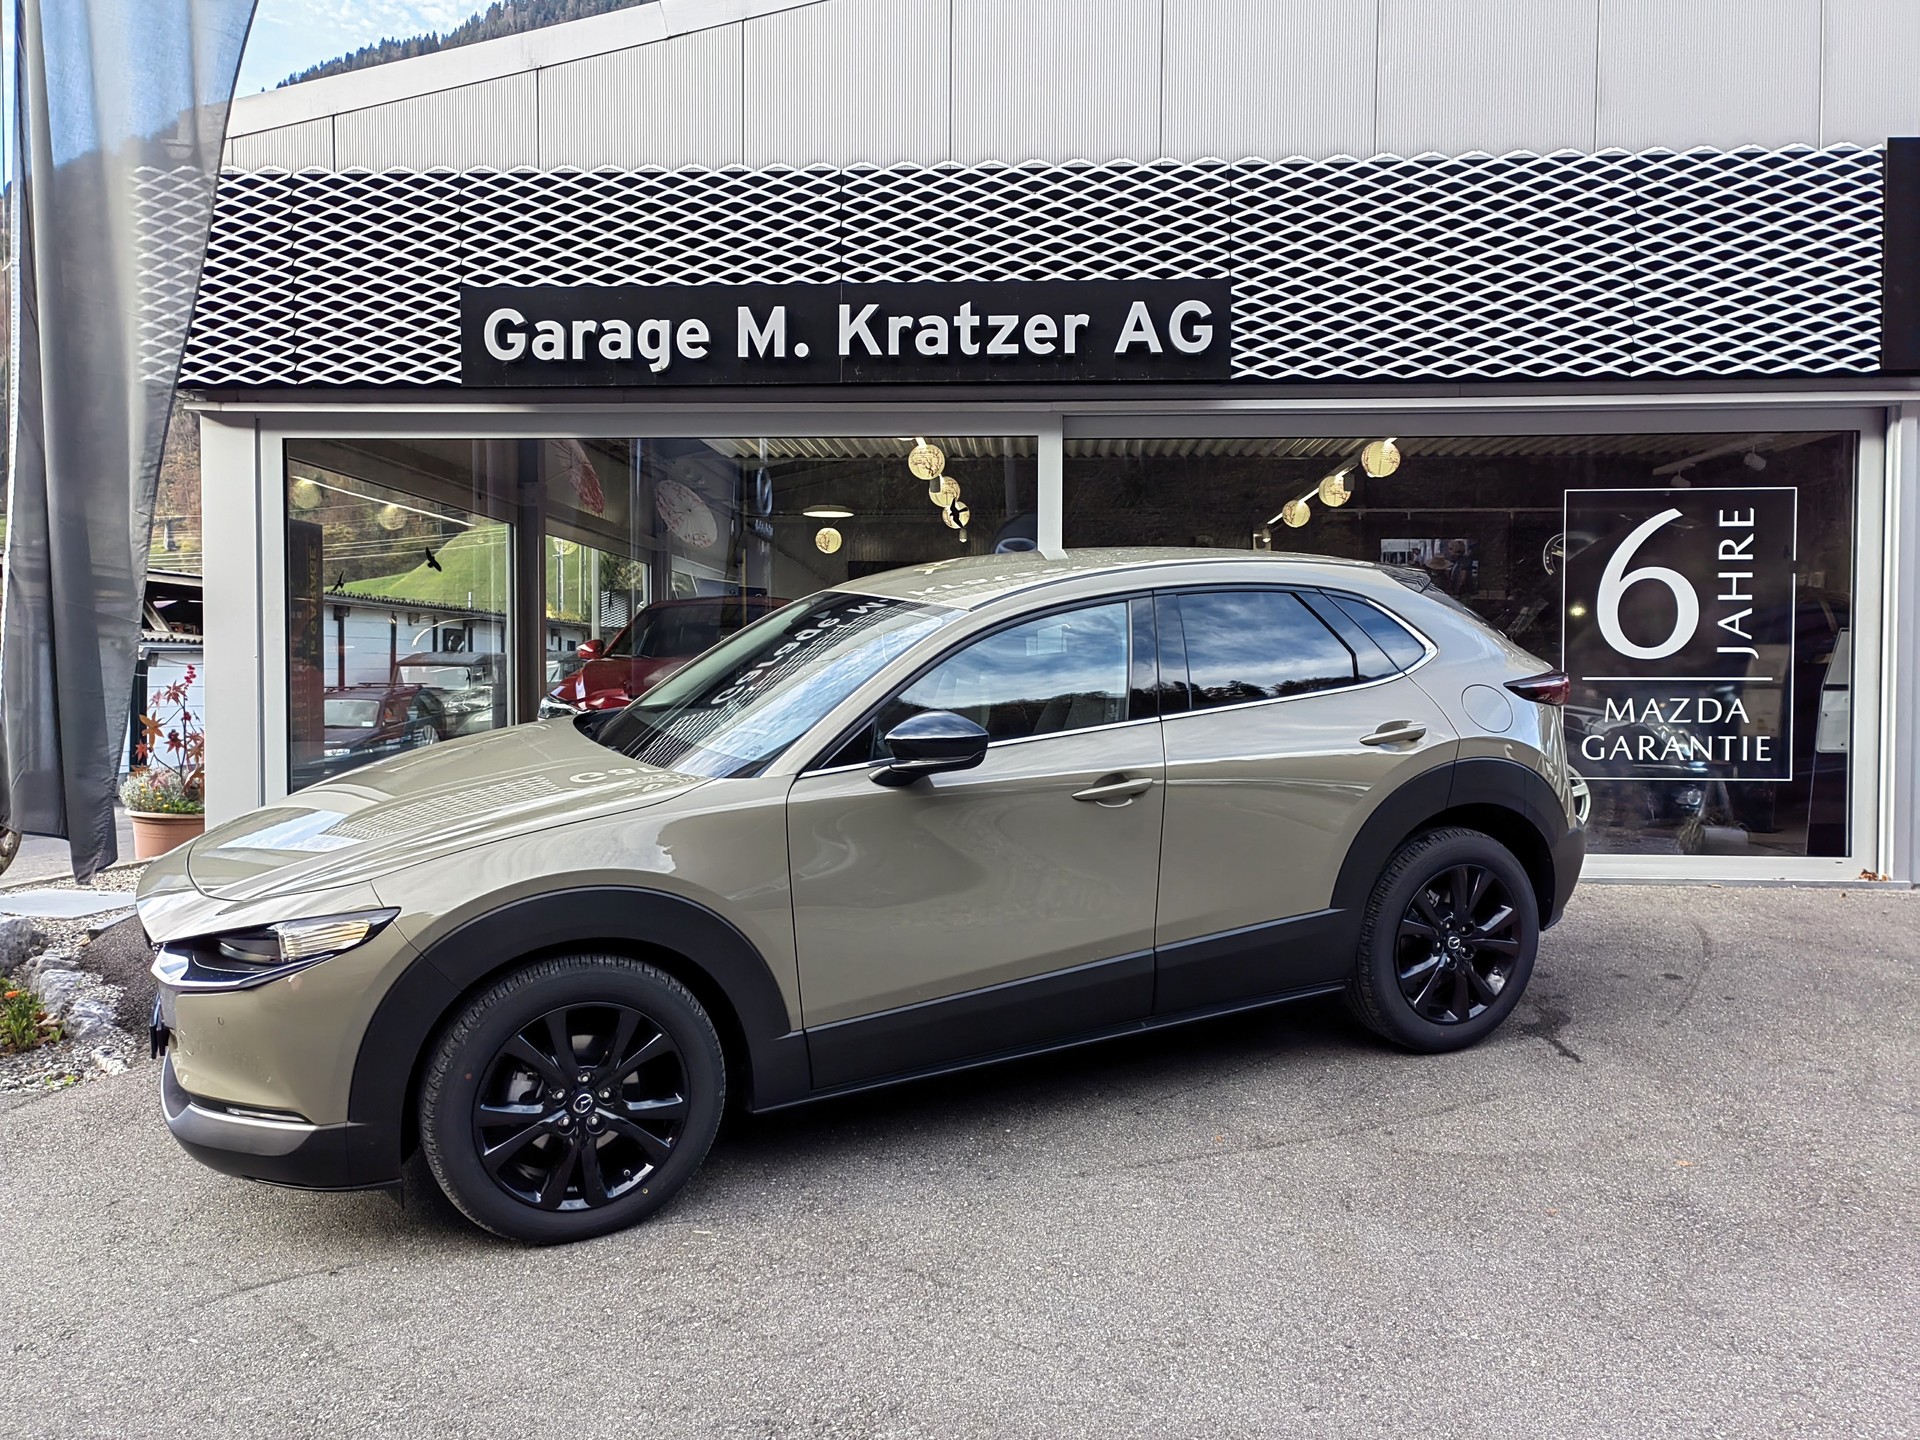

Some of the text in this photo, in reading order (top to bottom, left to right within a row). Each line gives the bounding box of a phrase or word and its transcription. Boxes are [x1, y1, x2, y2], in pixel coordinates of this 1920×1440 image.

[484, 300, 1213, 373] Garage M. Kratzer AG
[1597, 508, 1699, 660] 6
[1716, 507, 1759, 660] JAHRE
[1604, 698, 1750, 723] MAZDA
[1581, 735, 1771, 762] GARANTIE
